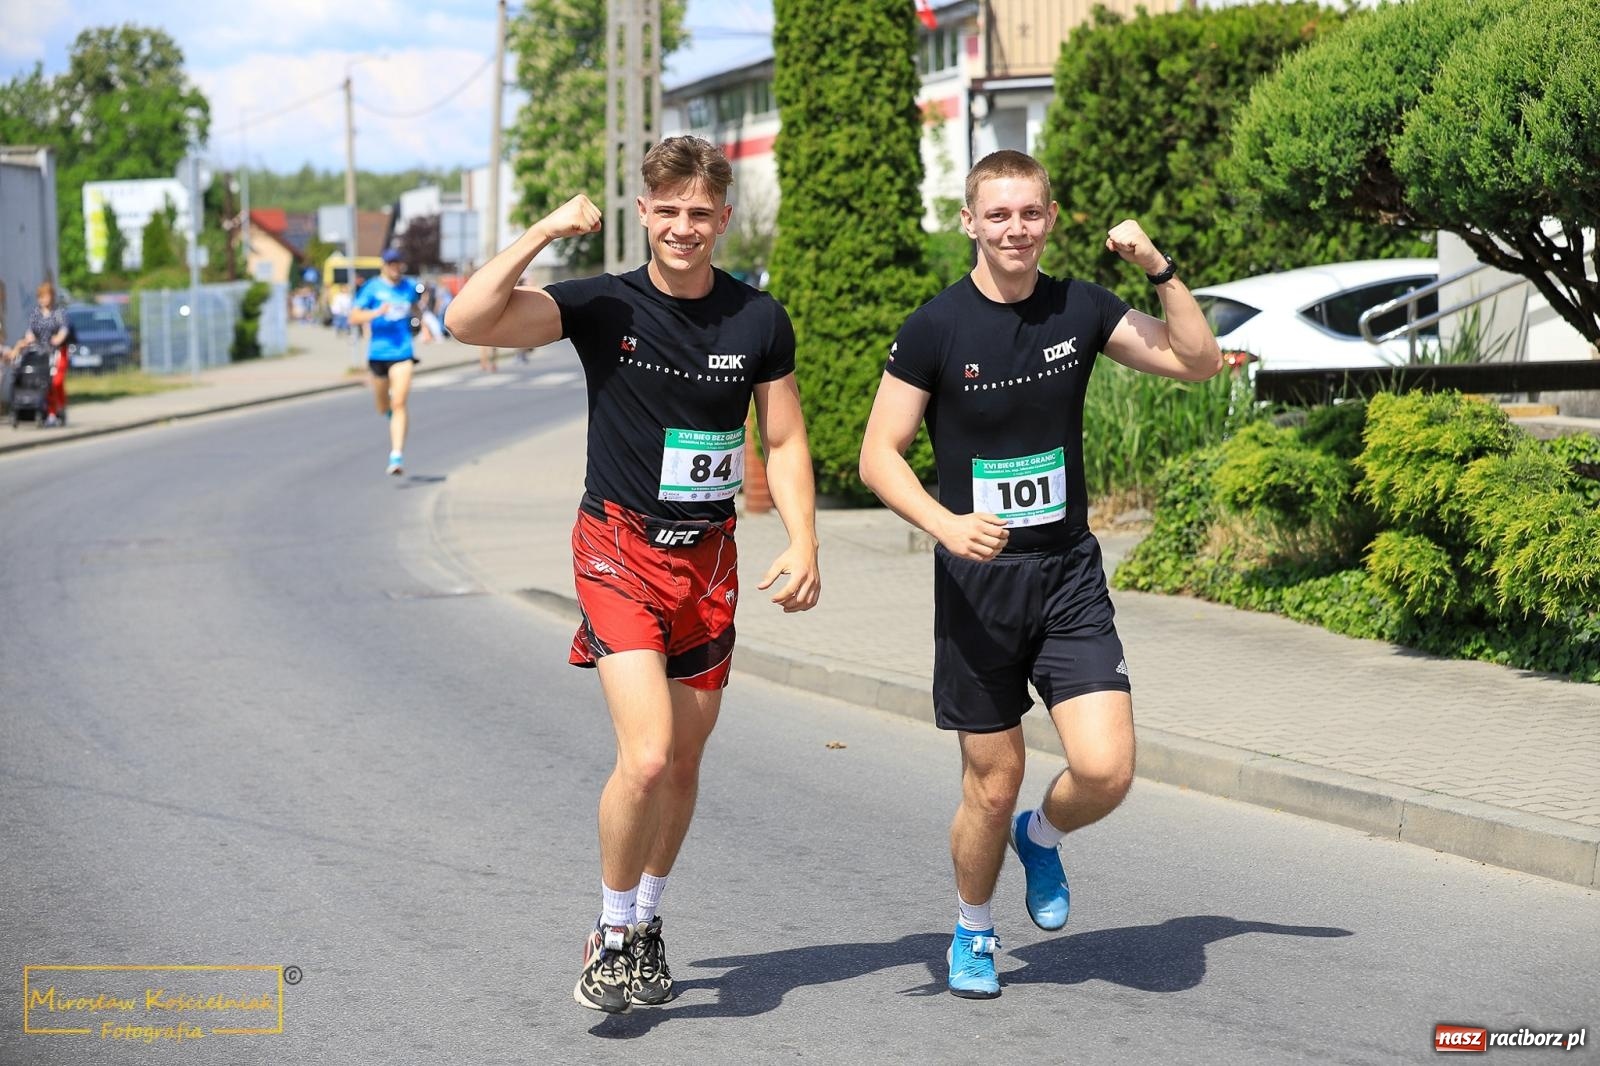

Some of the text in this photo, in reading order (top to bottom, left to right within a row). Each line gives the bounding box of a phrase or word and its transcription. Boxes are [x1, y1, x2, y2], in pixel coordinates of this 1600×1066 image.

[708, 354, 745, 369] DZIK
[1043, 338, 1077, 362] DZIK
[619, 356, 745, 382] SPORTOWA POLSKA
[964, 359, 1079, 391] SPORTOWA POLSKA
[678, 431, 692, 440] XVI
[690, 453, 733, 483] 84
[983, 462, 996, 470] XVI
[1015, 459, 1030, 467] BEZ
[1030, 453, 1056, 465] GRANIC
[997, 476, 1051, 510] 101
[654, 529, 699, 545] UFC
